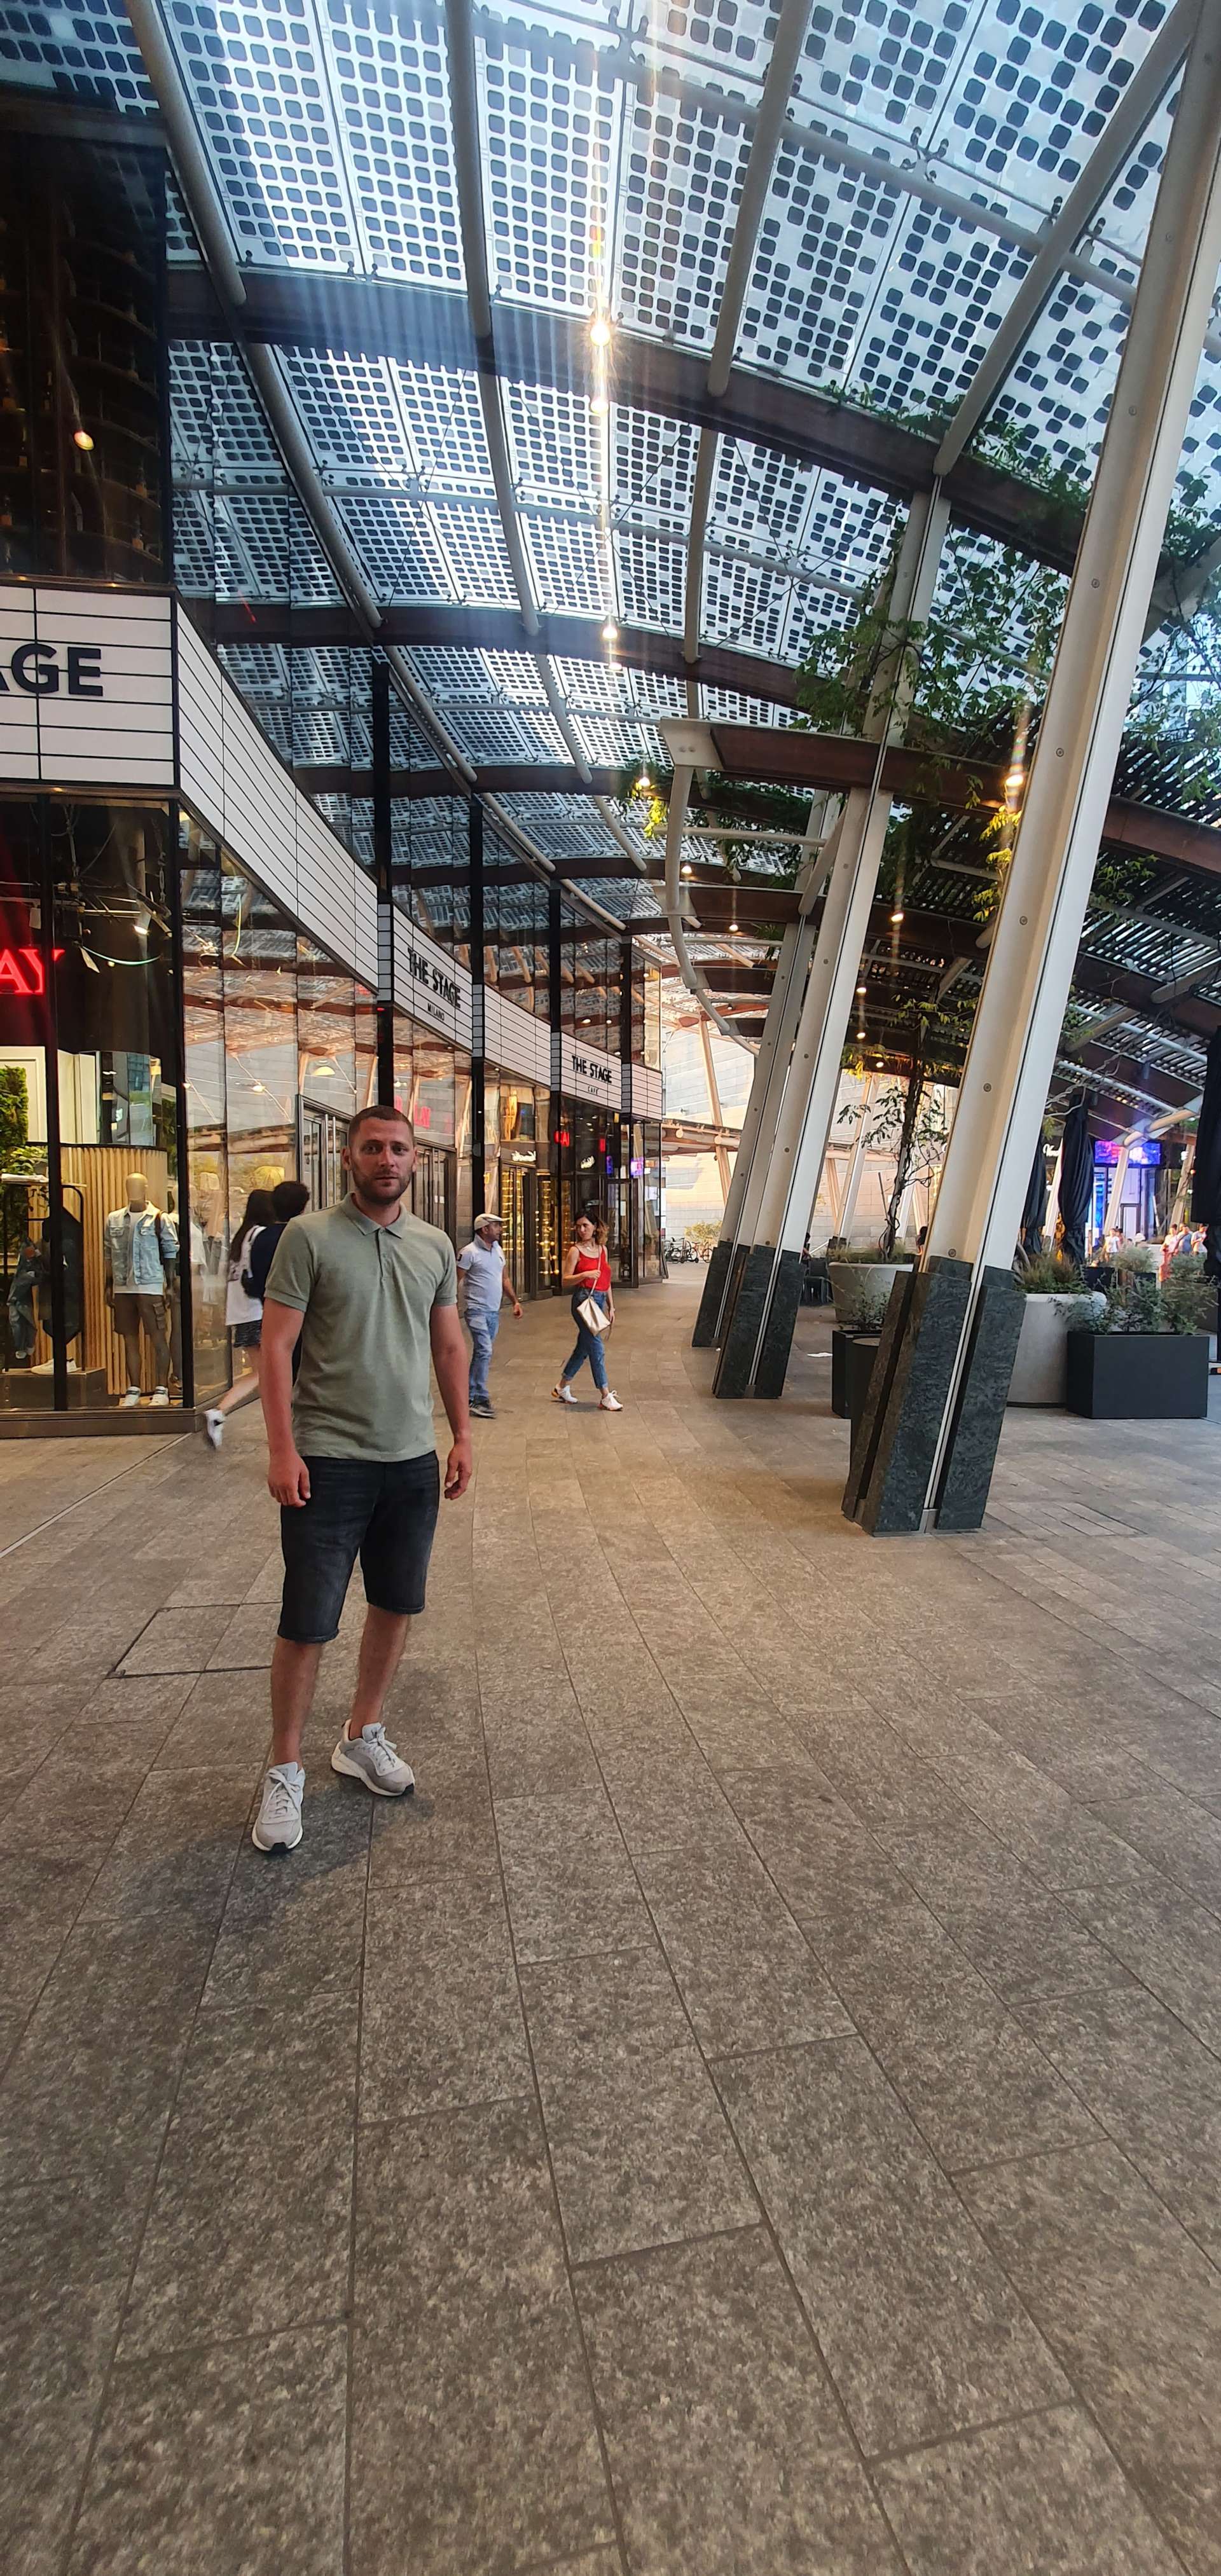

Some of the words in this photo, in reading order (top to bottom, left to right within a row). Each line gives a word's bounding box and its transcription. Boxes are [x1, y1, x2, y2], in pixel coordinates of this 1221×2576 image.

[0, 643, 103, 696] GE
[408, 947, 429, 984] THE
[432, 968, 461, 1009] STAGE
[427, 1003, 445, 1021] MILANO
[572, 1055, 587, 1074] THE
[590, 1063, 612, 1084] STAGE
